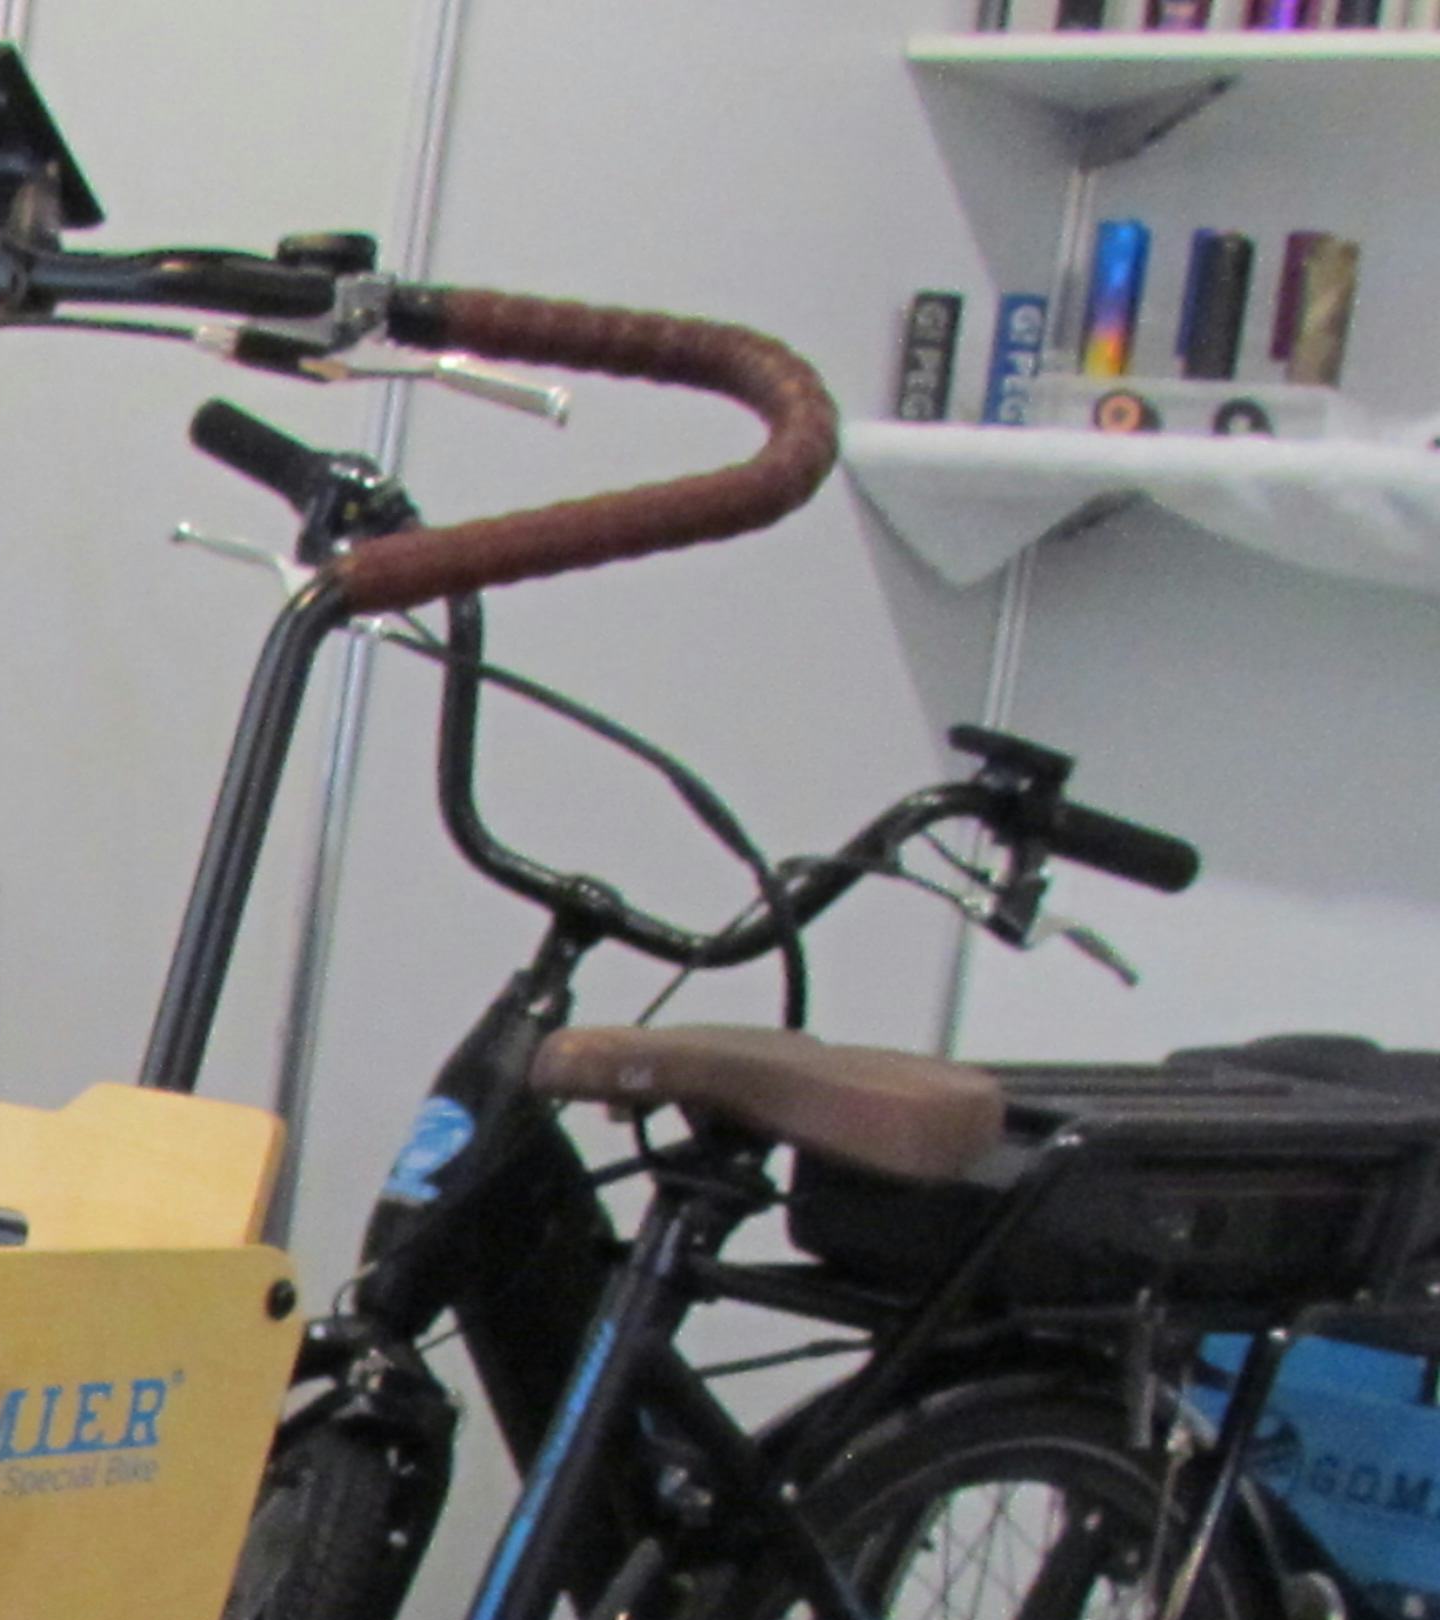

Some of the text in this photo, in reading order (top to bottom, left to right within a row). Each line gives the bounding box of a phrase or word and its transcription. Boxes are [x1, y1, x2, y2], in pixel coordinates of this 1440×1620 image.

[1, 1456, 98, 1496] Special
[104, 1454, 160, 1487] Bike
[1309, 1453, 1440, 1522] GOM
